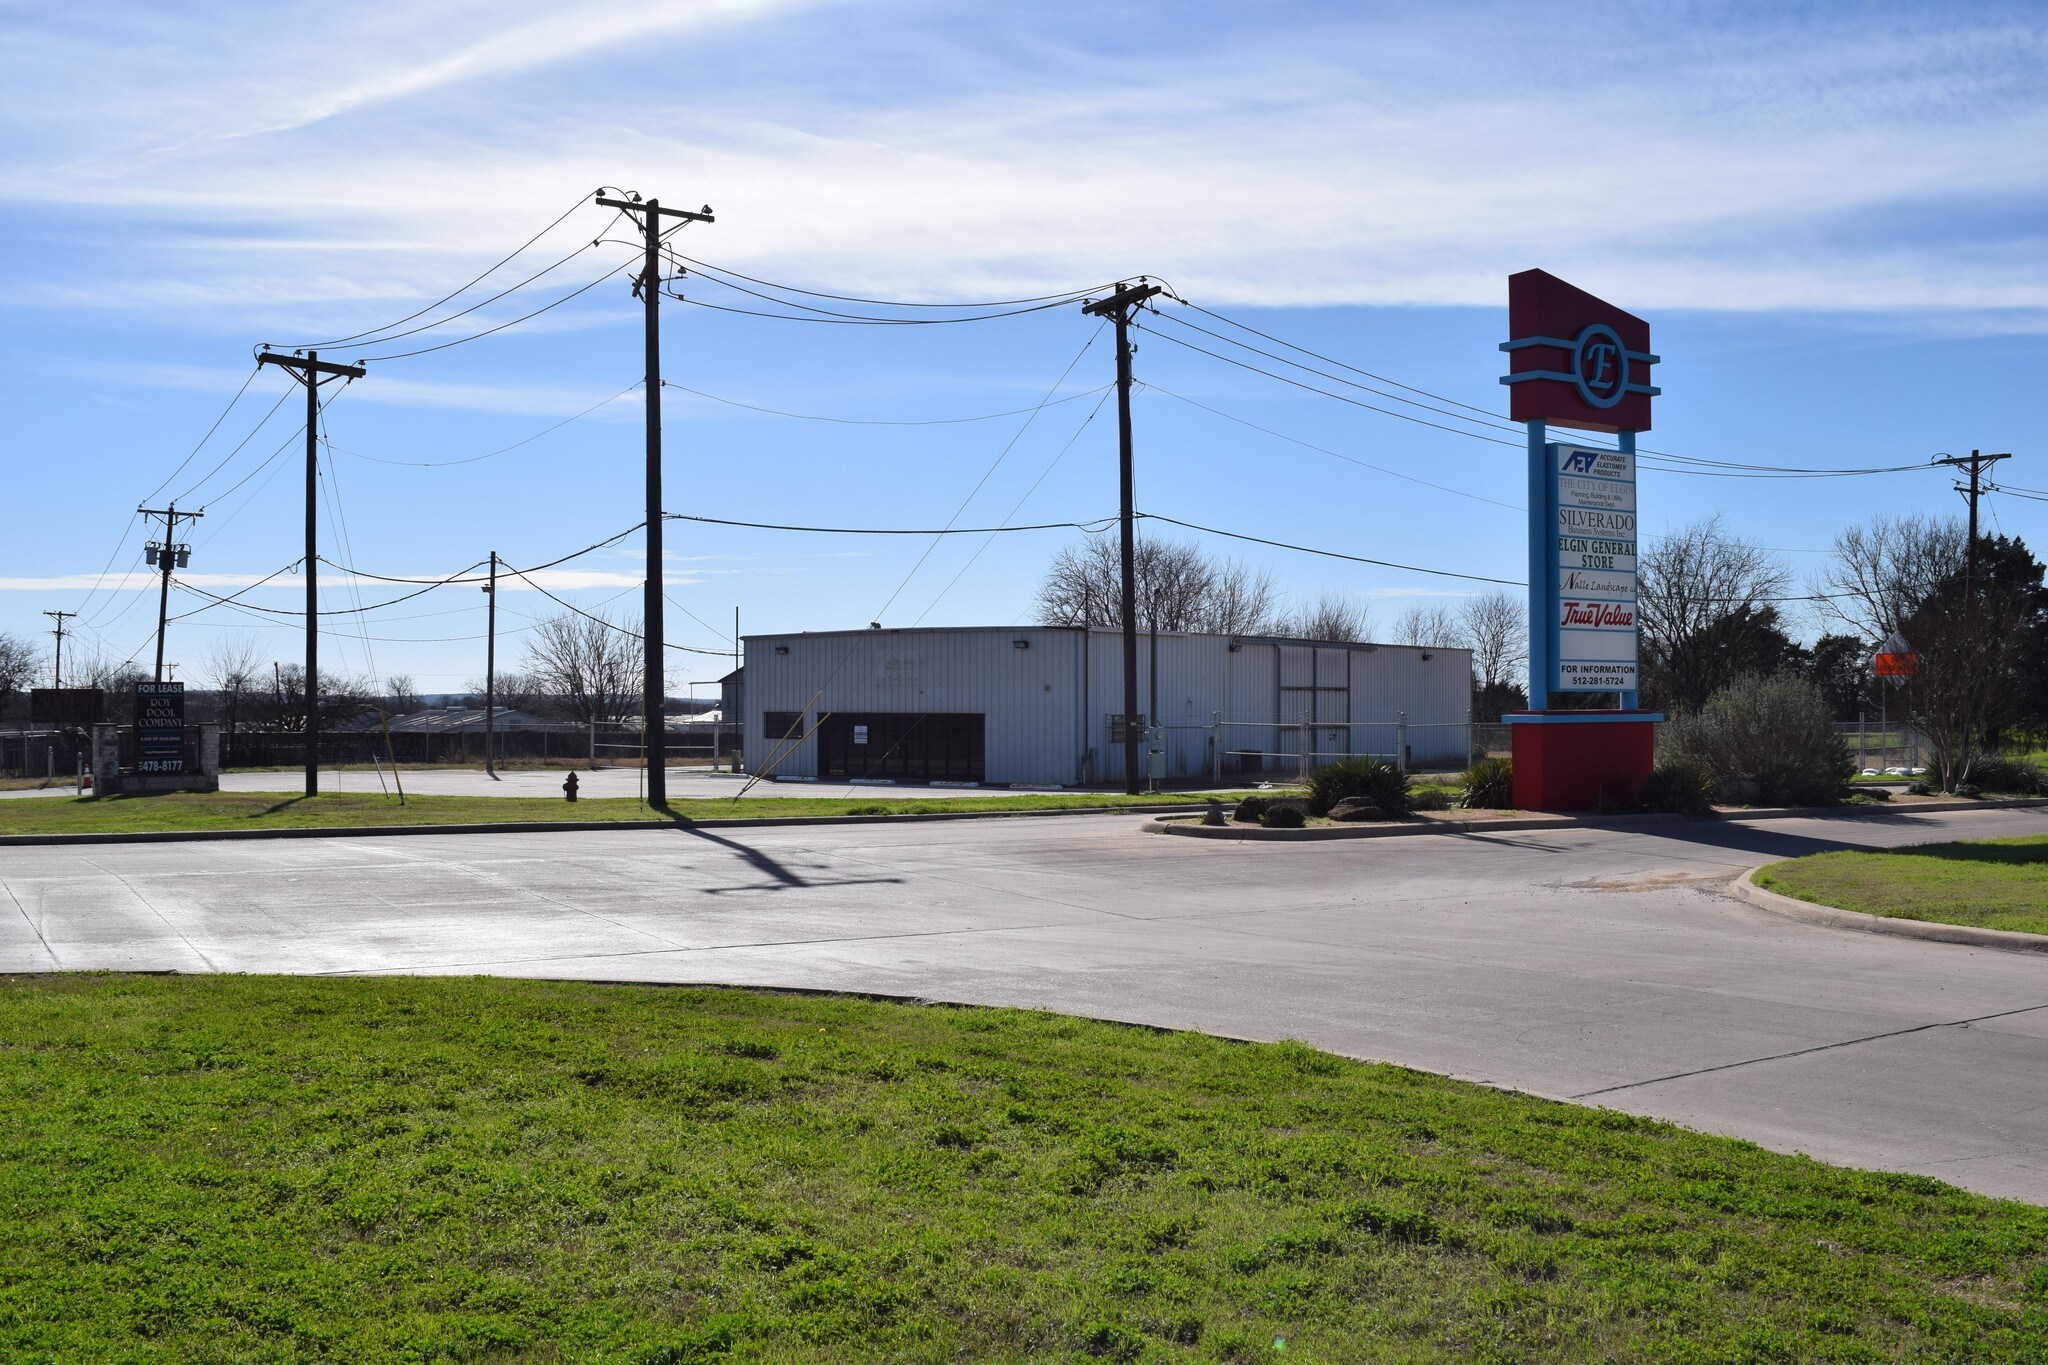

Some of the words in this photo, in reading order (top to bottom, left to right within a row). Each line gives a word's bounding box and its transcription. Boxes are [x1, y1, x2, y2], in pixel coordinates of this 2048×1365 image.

[1600, 454, 1626, 463] ACCURATE
[1597, 462, 1626, 470] ELASTOMER
[1593, 469, 1620, 477] PRODUCTS
[1560, 478, 1575, 488] THE
[1577, 480, 1596, 490] CITY
[1599, 483, 1608, 491] OF
[1611, 484, 1633, 494] ELGIN
[1591, 492, 1607, 501] Building
[1560, 509, 1634, 530] SILVERADO
[1568, 526, 1592, 535] Business
[1593, 528, 1615, 537] Systems
[1559, 538, 1588, 552] ELGIN
[1591, 540, 1636, 556] GENERAL
[1582, 555, 1614, 568] STORE
[1590, 581, 1628, 598] Landscape
[1562, 665, 1577, 673] FOR
[1581, 665, 1635, 674] INFORMATION
[1572, 677, 1624, 685] 512-281-5724
[138, 684, 155, 693] FOR
[158, 684, 182, 693] LEASE
[150, 698, 171, 707] ROY
[146, 708, 175, 717] POOL
[138, 718, 182, 727] COMPANY
[143, 761, 182, 772] 478-8177
